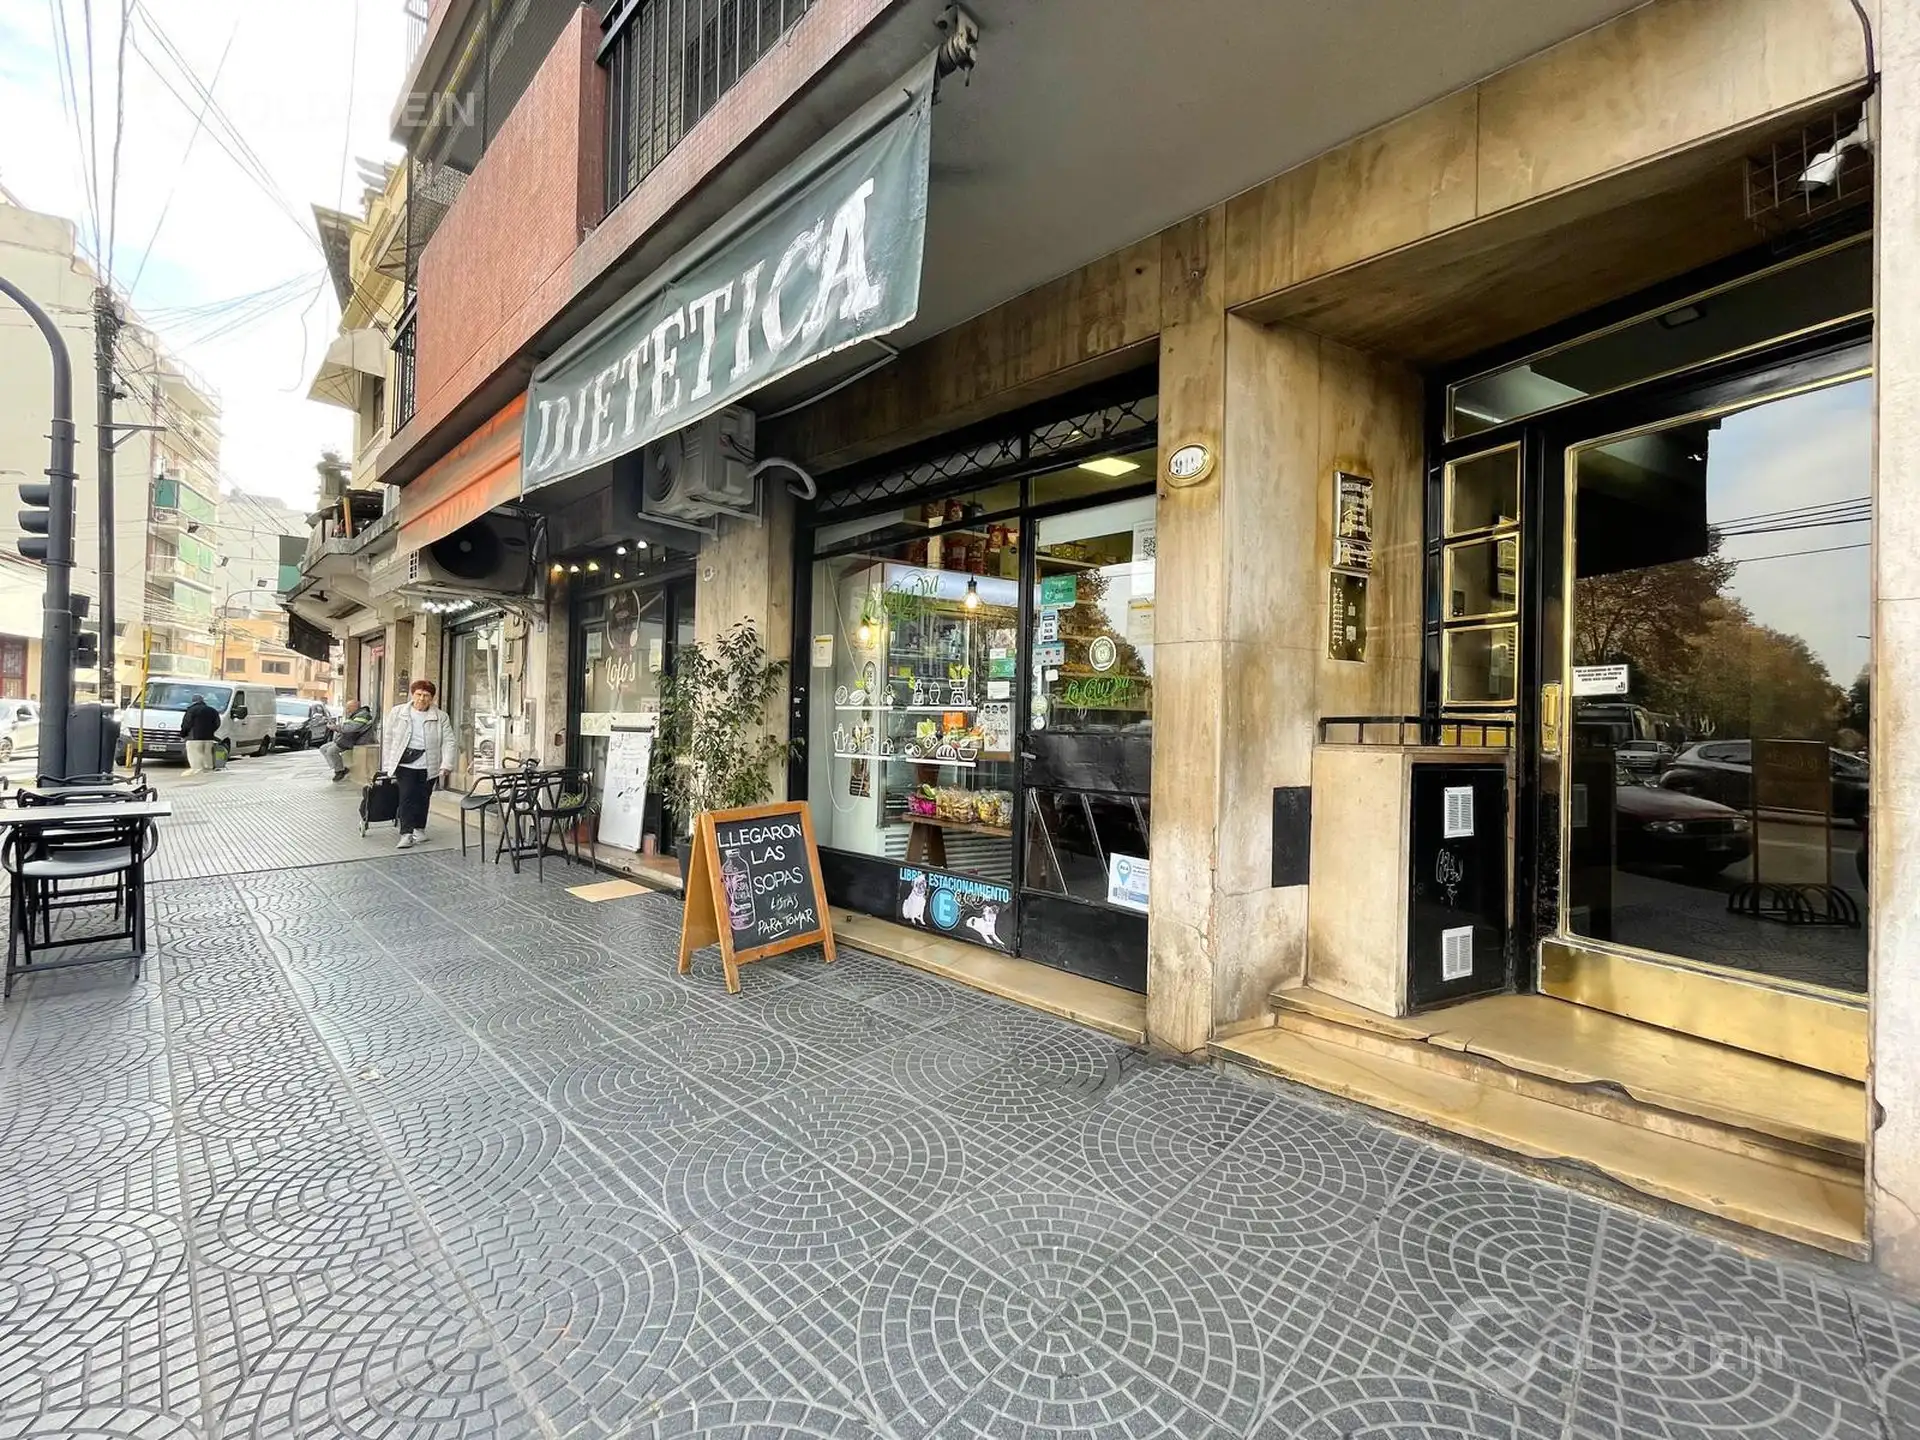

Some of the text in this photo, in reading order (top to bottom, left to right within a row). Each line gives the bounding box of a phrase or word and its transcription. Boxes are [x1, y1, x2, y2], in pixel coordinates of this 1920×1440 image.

[529, 177, 882, 472] DIETETICA
[717, 824, 802, 848] LLEGARON
[750, 845, 786, 864] LAS
[753, 866, 804, 895] SOPAS
[758, 908, 815, 936] PARA TOMAR
[941, 894, 952, 922] E
